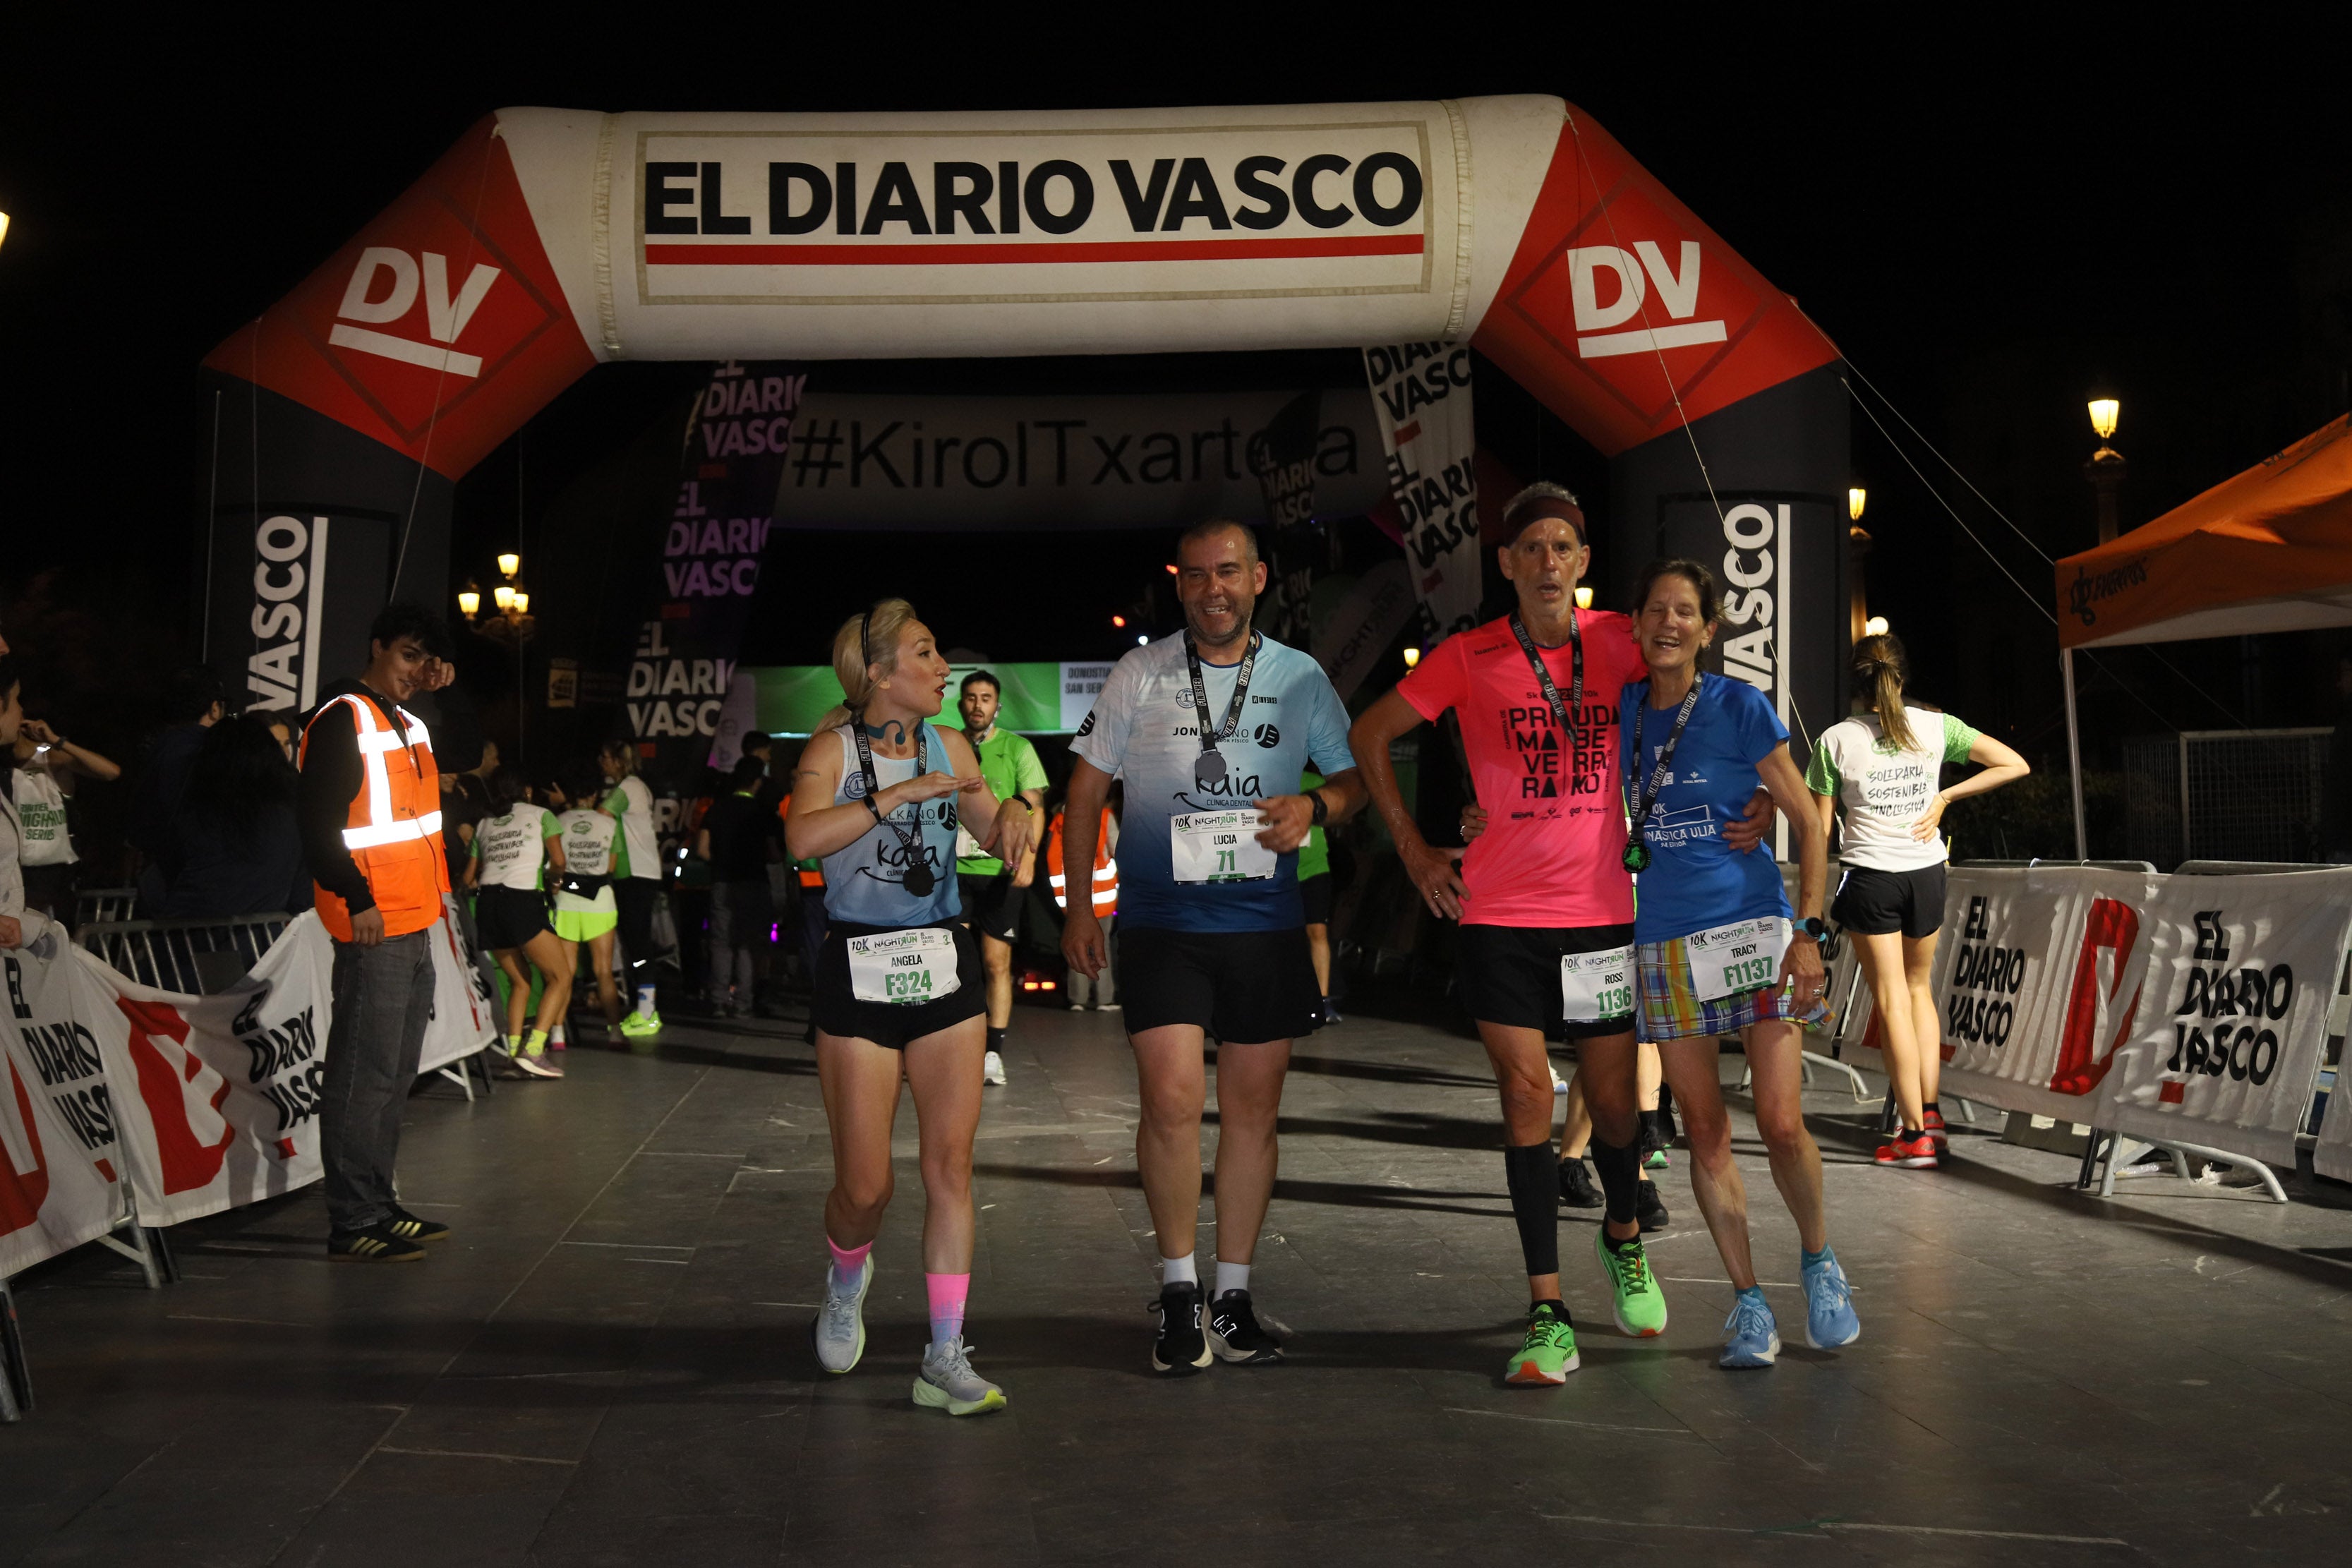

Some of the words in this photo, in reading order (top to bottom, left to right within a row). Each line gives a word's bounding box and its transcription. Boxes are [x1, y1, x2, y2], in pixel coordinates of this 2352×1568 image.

[645, 161, 751, 235] EL
[768, 159, 1094, 235] DIARIO
[1108, 151, 1423, 232] VASCO
[337, 247, 502, 344] DV
[1567, 240, 1701, 332] DV
[701, 416, 795, 458] VASC
[791, 416, 1359, 488] #KirolTxarta
[663, 559, 761, 598] VASC
[245, 515, 308, 713] VASCO
[1676, 690, 1697, 726] FINISHER
[1173, 727, 1198, 736] JON
[888, 809, 936, 821] LKANO
[1213, 834, 1238, 845] LUCIA
[1216, 850, 1236, 872] 71
[1964, 895, 1988, 939] EL
[2193, 910, 2230, 961] EL
[851, 938, 869, 951] 10K
[891, 954, 923, 967] ANGELA
[1730, 943, 1757, 958] TRACY
[4, 956, 33, 1019] EL
[884, 969, 933, 996] F324
[1604, 972, 1624, 985] ROSS
[1723, 955, 1773, 988] F1137
[1953, 944, 2025, 994] DIARIO
[1596, 985, 1632, 1012] 1136
[1948, 994, 2013, 1047] VASCO
[20, 1020, 104, 1086] DIARIO
